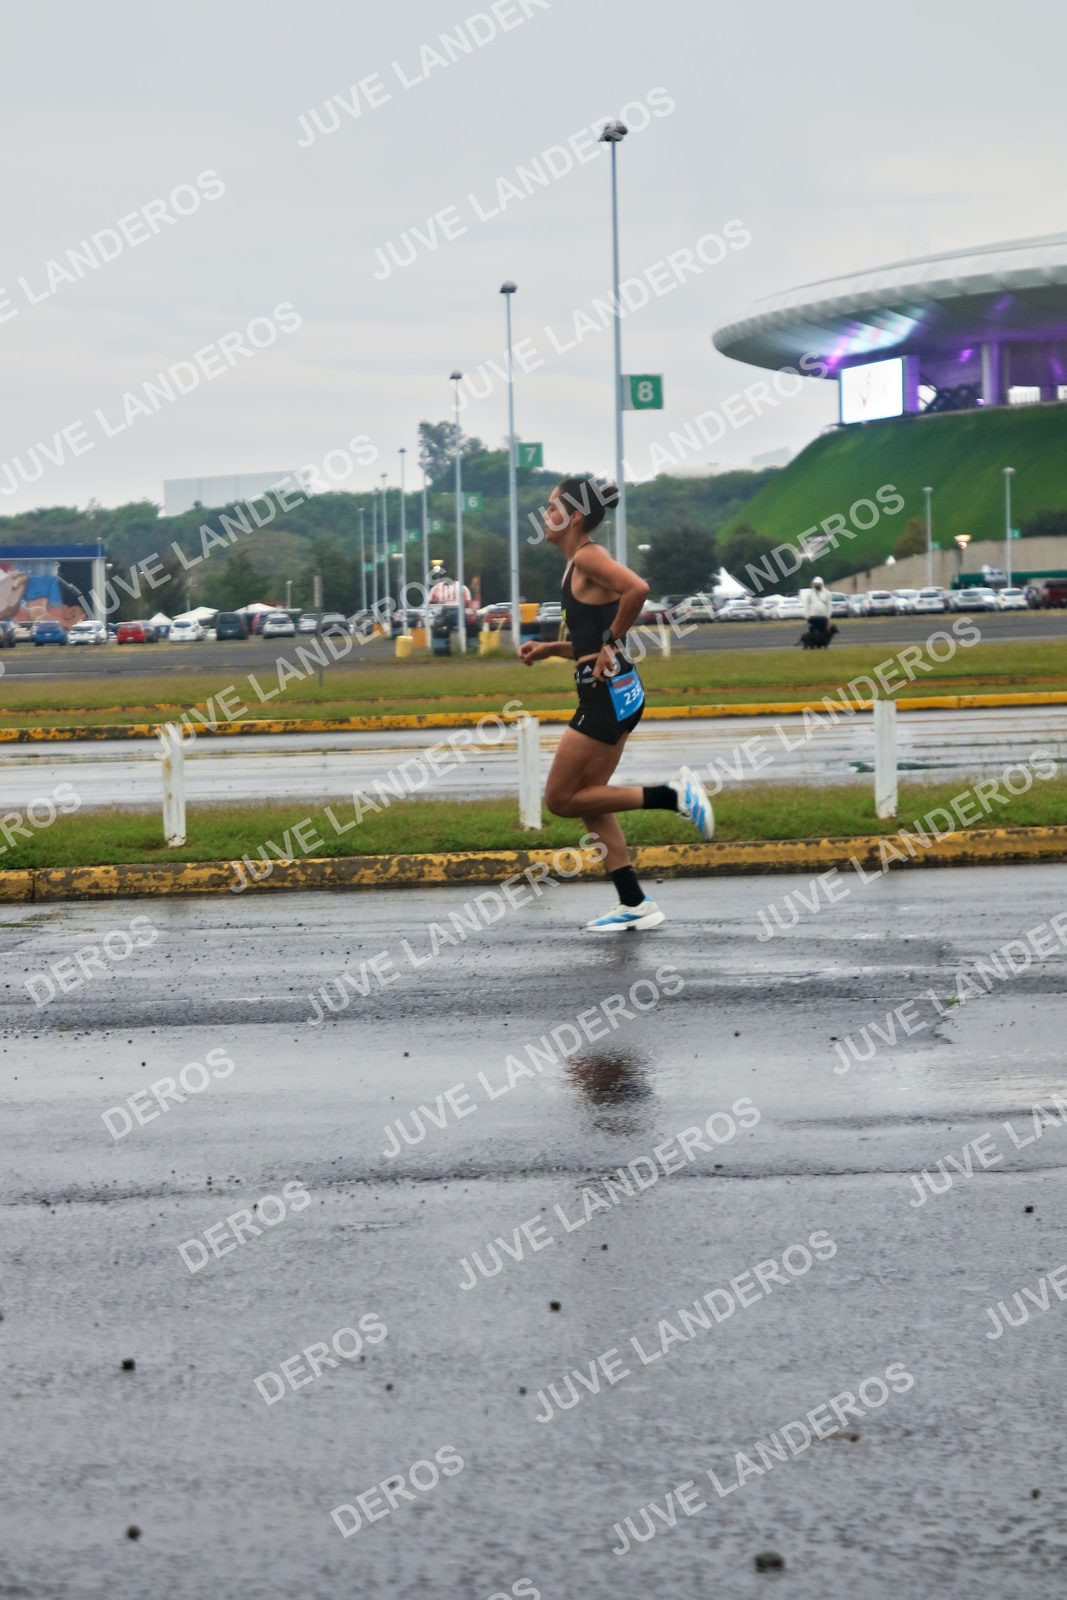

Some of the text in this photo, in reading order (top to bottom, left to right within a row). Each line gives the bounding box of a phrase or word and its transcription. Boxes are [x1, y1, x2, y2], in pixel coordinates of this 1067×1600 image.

[637, 381, 654, 402] 8
[525, 447, 537, 462] 7
[468, 496, 478, 508] 6
[432, 520, 441, 530] 5
